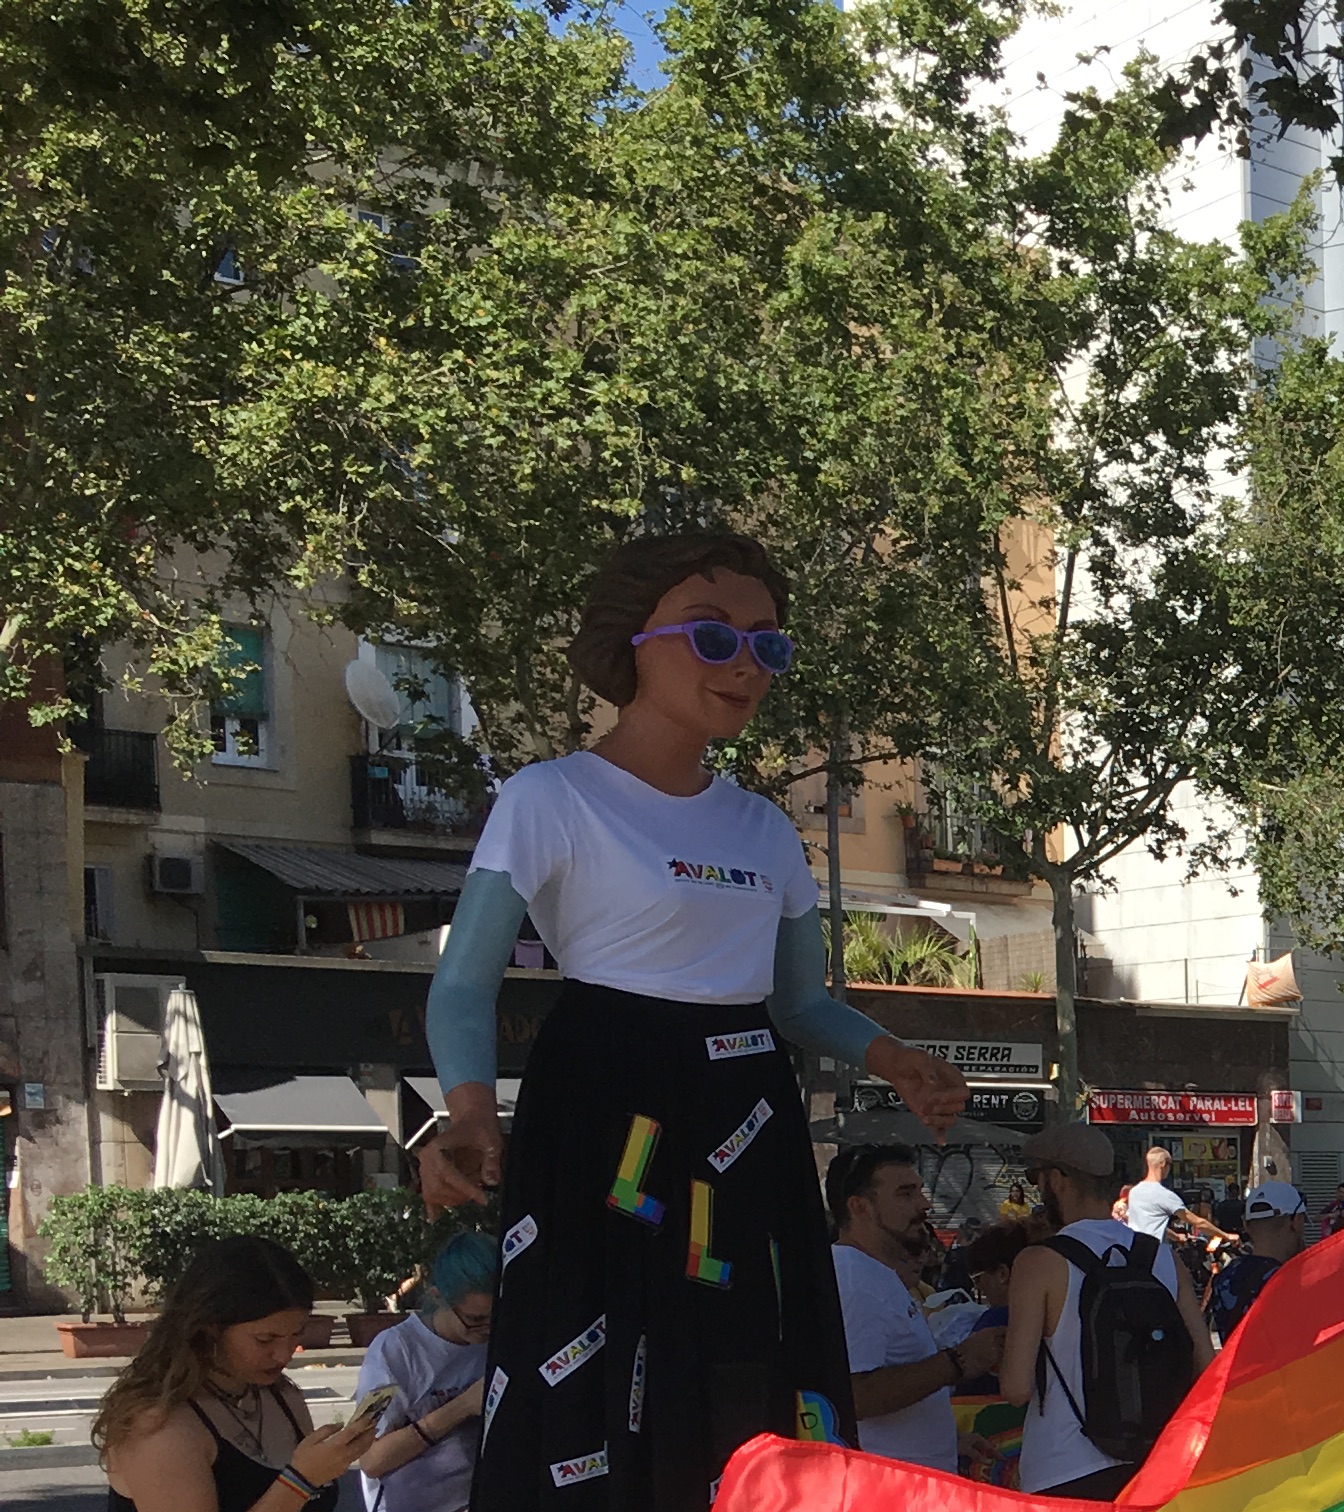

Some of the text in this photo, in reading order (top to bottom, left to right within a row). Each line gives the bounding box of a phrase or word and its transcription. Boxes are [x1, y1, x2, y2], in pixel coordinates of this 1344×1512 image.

[672, 860, 757, 887] AVALOT
[713, 1033, 765, 1052] AVALOT
[915, 1044, 1012, 1063] OS SERRA
[973, 1094, 1009, 1110] RENT
[1091, 1094, 1183, 1110] SUPERMERCAT
[1128, 1109, 1216, 1122] Autoservei
[714, 1111, 760, 1164] AVALOT
